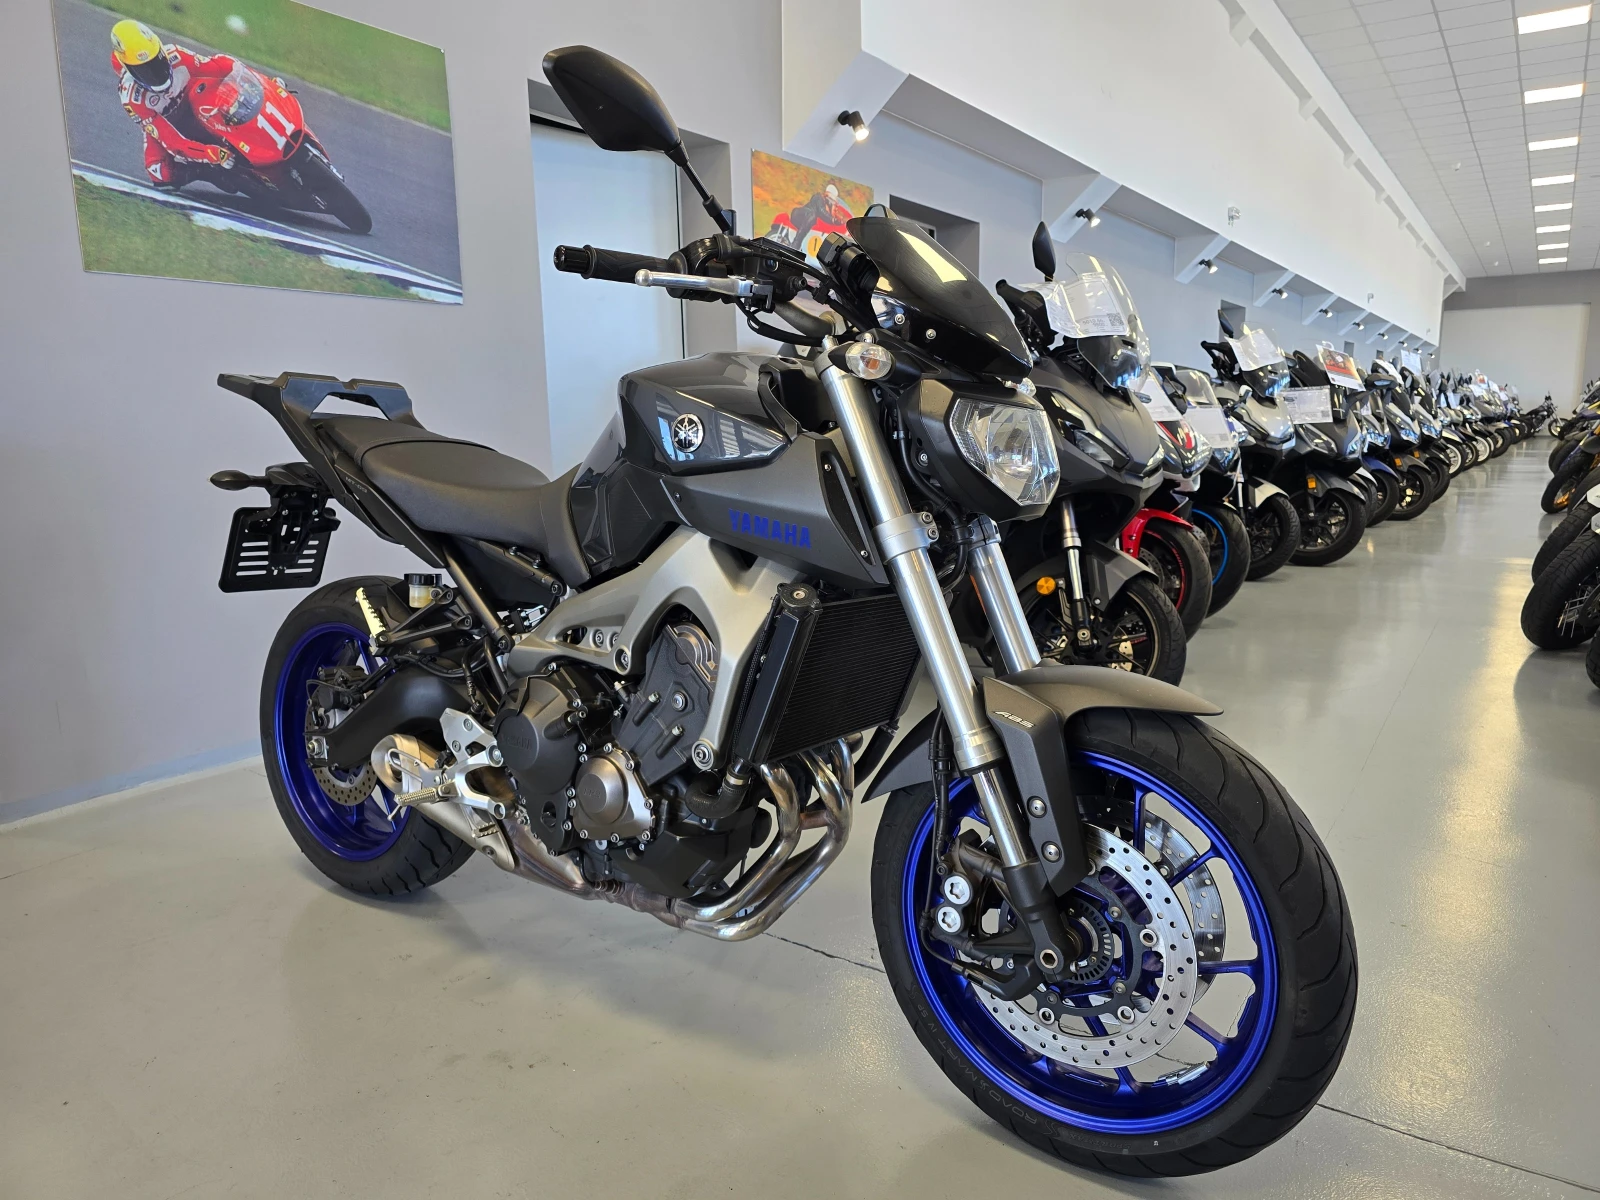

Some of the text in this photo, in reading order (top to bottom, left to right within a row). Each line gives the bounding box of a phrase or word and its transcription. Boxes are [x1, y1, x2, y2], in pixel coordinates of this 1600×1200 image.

[257, 101, 296, 150] 11
[728, 508, 812, 550] YAMAHA
[993, 711, 1035, 728] ABS
